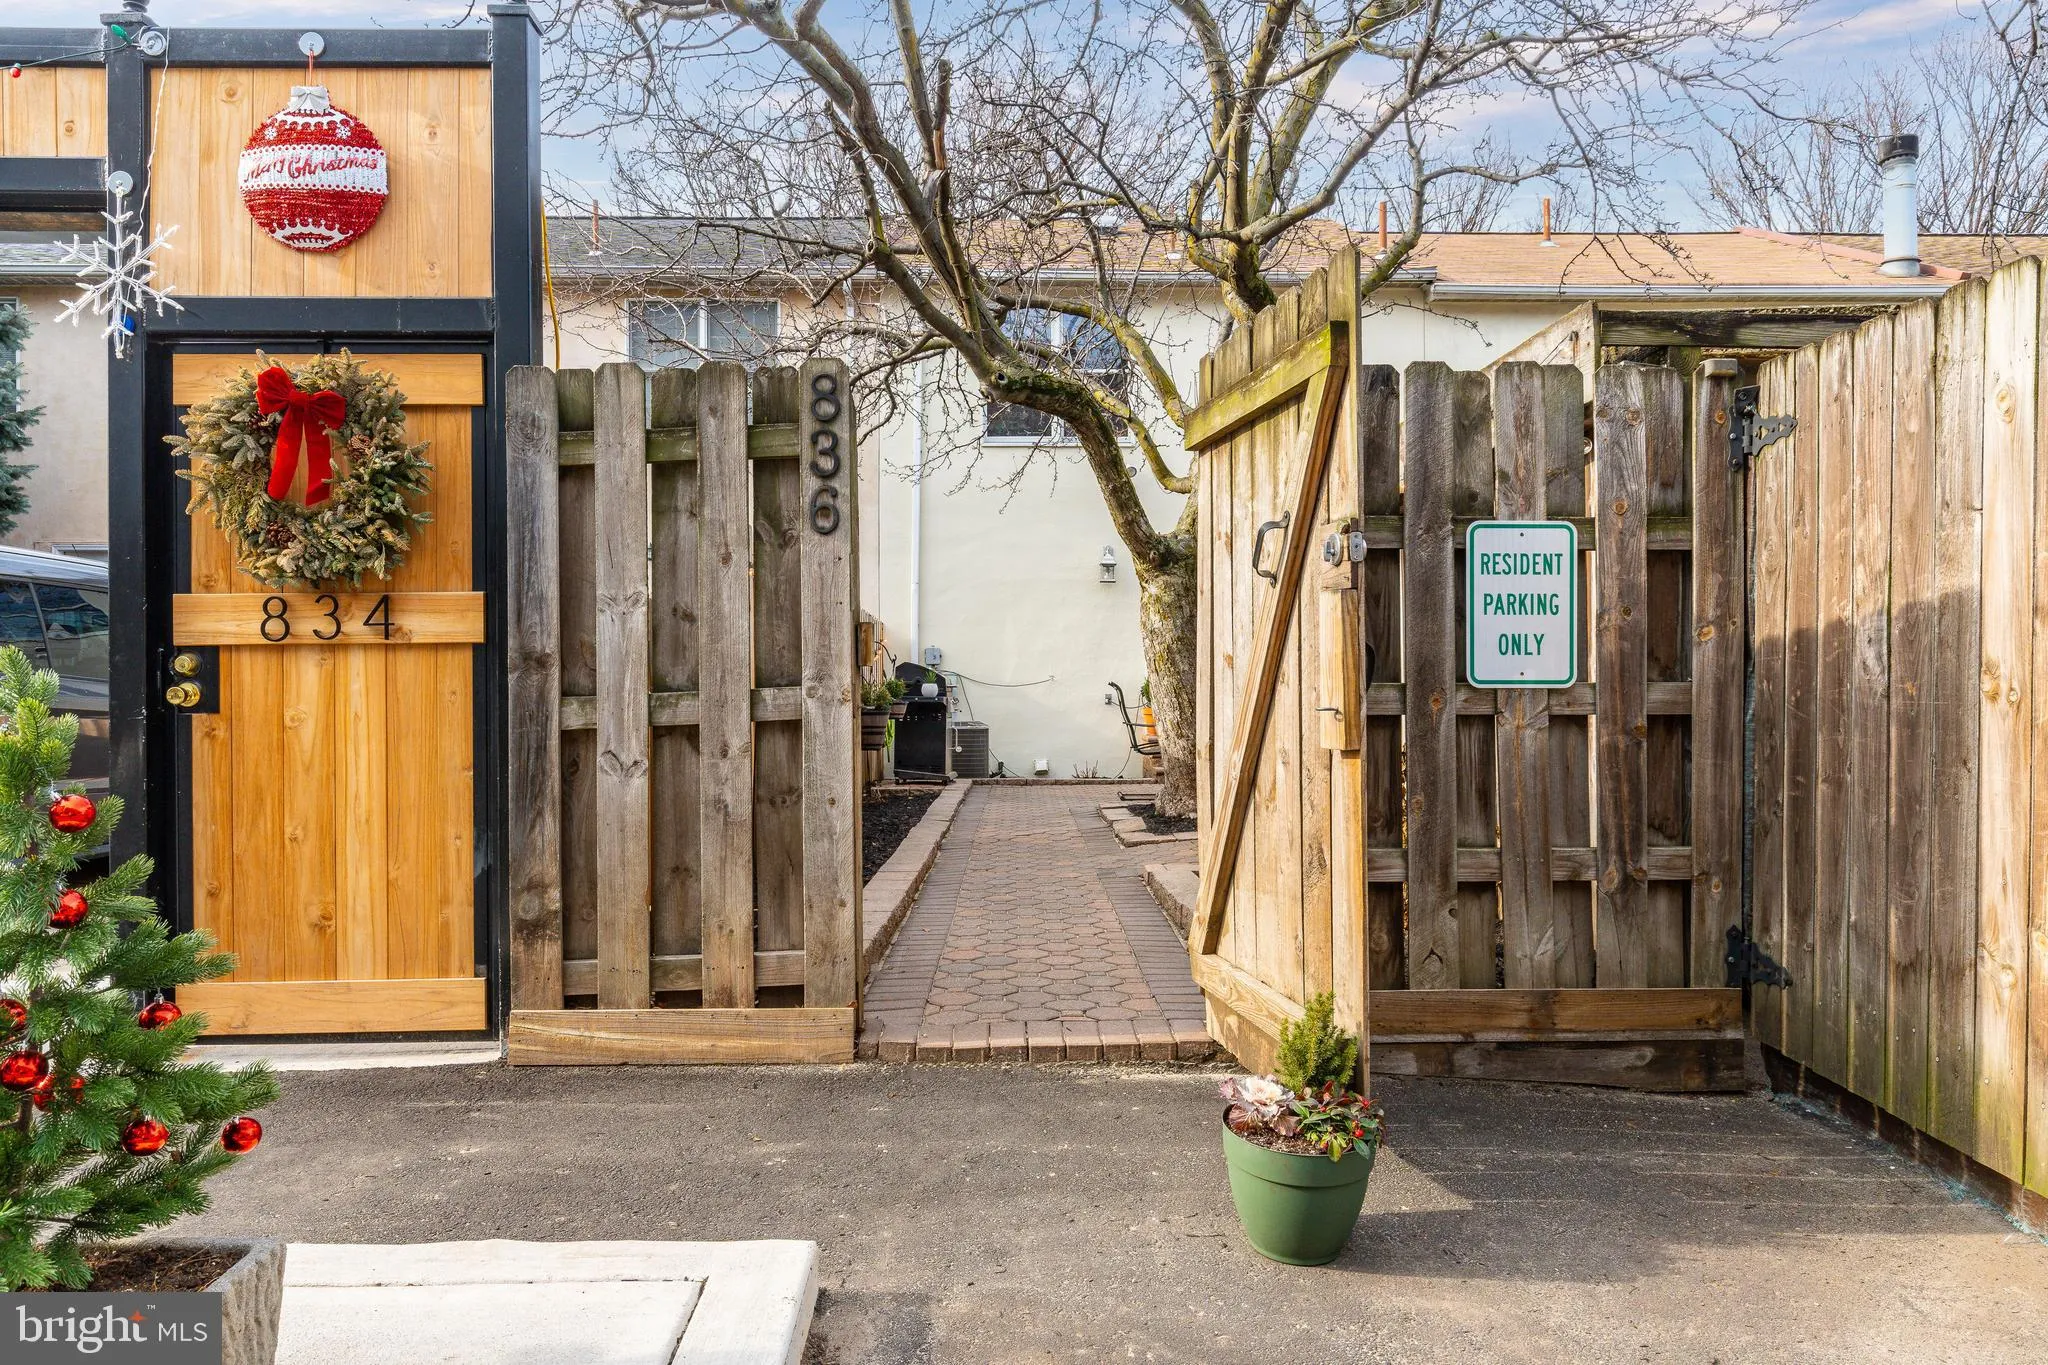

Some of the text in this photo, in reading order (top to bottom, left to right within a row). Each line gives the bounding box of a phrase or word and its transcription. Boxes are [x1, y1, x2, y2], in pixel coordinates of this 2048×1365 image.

[287, 153, 378, 179] Christmas
[810, 373, 841, 535] 836
[1480, 552, 1563, 576] RESIDENT
[1483, 593, 1560, 616] PARKING
[260, 594, 395, 643] 834
[1498, 633, 1545, 656] ONLY
